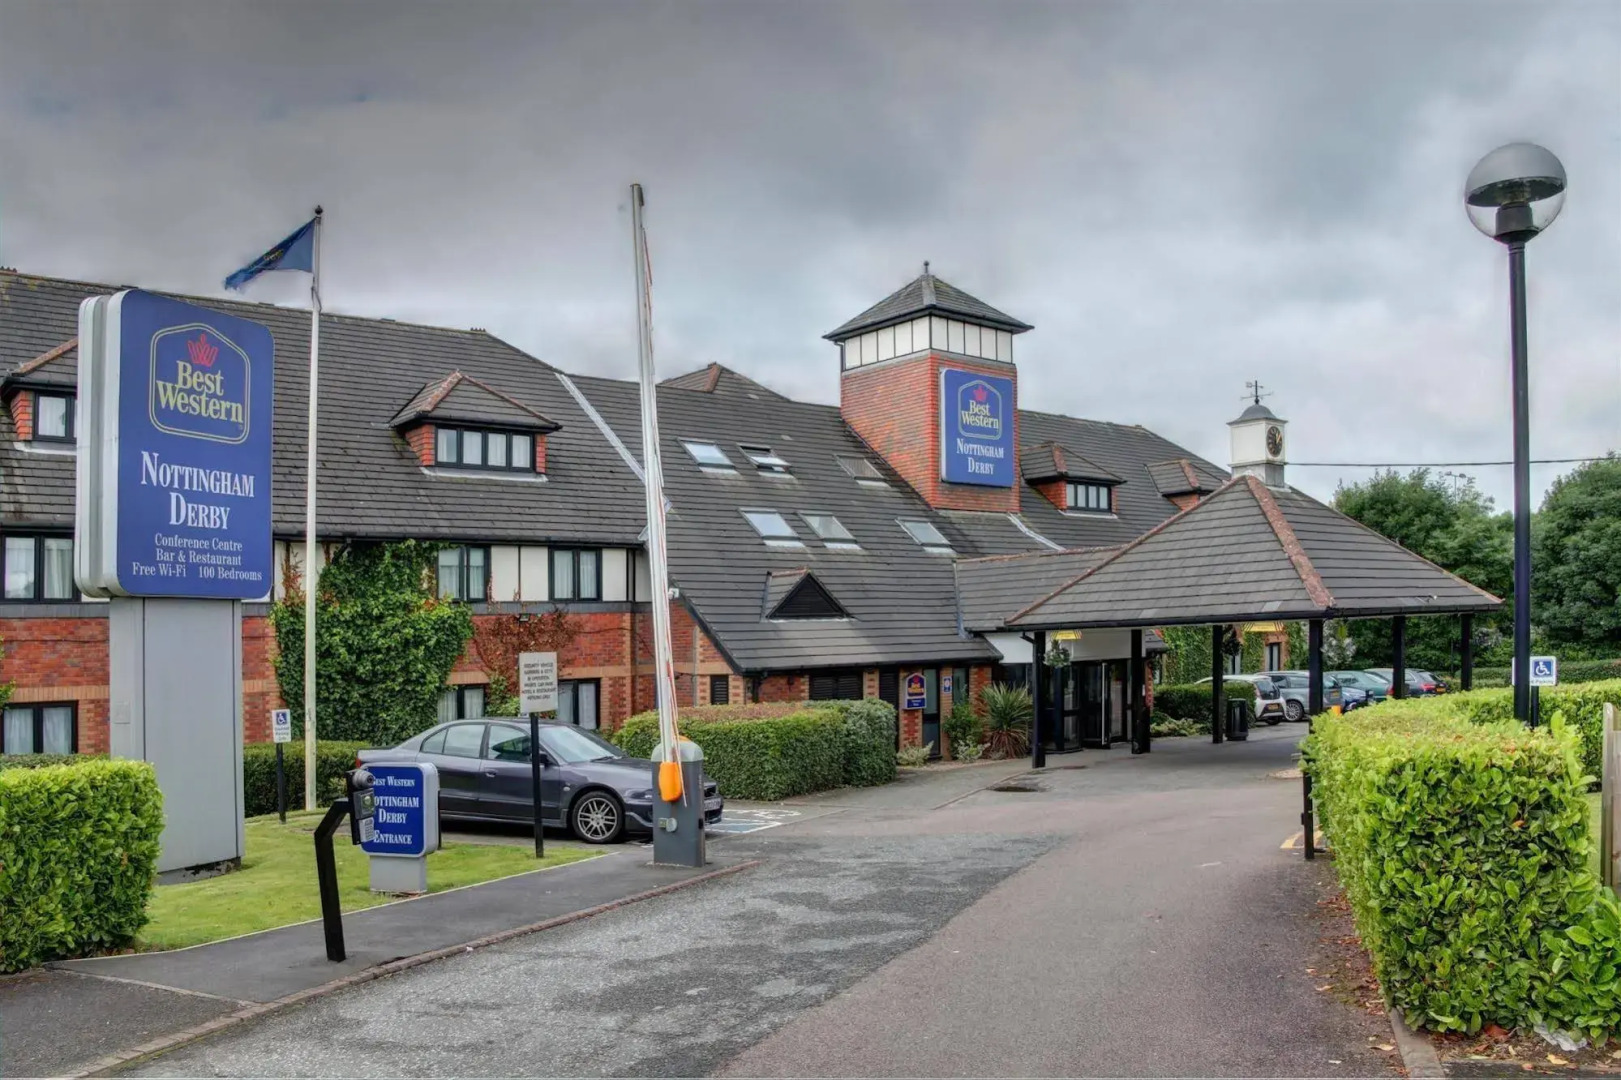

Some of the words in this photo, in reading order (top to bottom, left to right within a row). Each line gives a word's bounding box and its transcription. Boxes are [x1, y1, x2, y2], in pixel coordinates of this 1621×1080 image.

[176, 360, 224, 396] Best
[156, 380, 243, 424] Western
[969, 400, 991, 416] Best
[961, 411, 999, 429] Western
[956, 438, 1005, 459] NOTTINGHAM
[141, 451, 255, 498] NOTTINGHAM
[968, 457, 994, 475] DERBY
[169, 492, 231, 530] DERBY
[154, 532, 210, 551] Conference
[212, 535, 243, 552] Centre
[156, 548, 176, 562] Bar
[178, 550, 186, 563] &
[189, 551, 242, 566] Restaurant
[132, 562, 156, 576] Free
[158, 563, 187, 578] Wi-Fi
[198, 565, 215, 579] 100
[217, 566, 263, 582] Bedrooms
[386, 776, 416, 786] WESTERN
[374, 795, 420, 808] OTTINGHAM
[378, 808, 408, 824] DERBY
[373, 830, 412, 844] ENTRANCE
